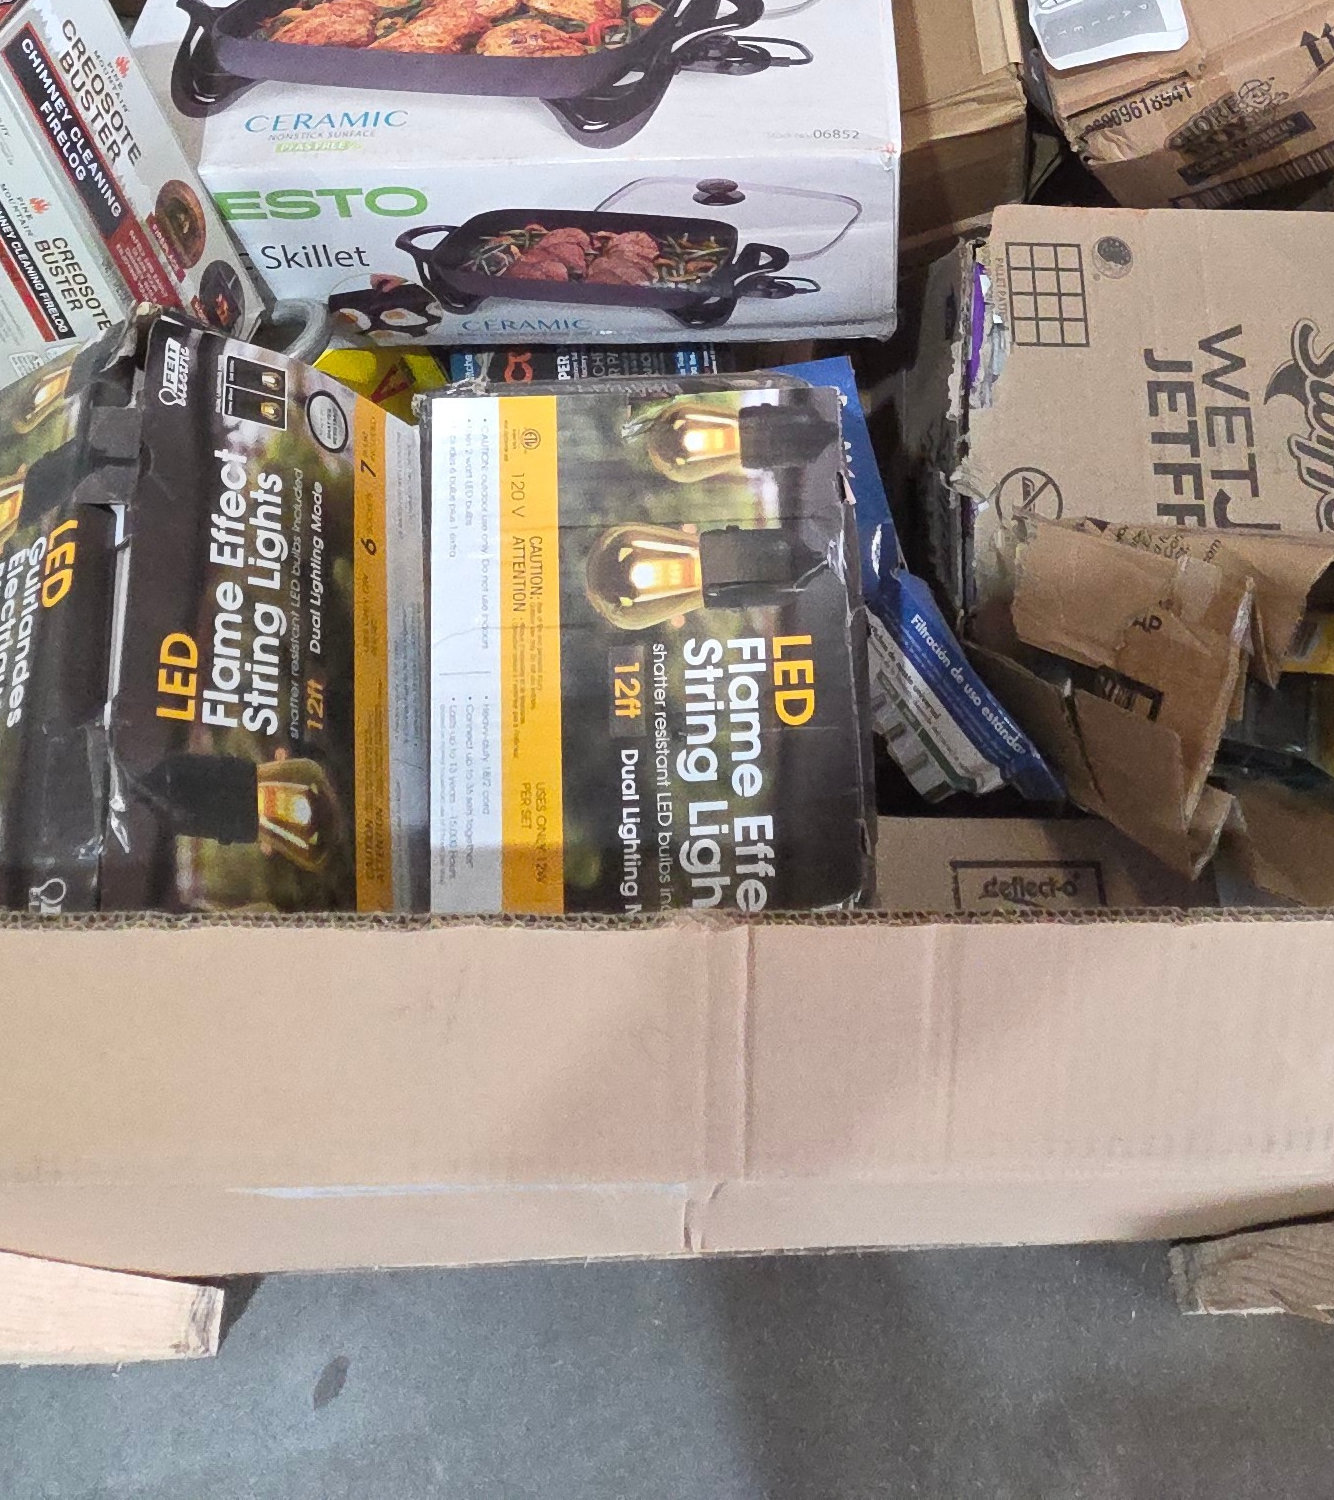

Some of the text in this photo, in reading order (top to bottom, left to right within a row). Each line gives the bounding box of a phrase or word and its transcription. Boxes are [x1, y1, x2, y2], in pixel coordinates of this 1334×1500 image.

[22, 38, 122, 218] CHIMNEY CLEANING
[58, 49, 122, 162] BUSTER
[62, 19, 142, 167] CREOSOTE
[244, 110, 410, 134] CERAMIC
[813, 129, 860, 140] 06852
[39, 100, 87, 182] FIRELOG
[0, 183, 33, 237] MOUNTAIN
[16, 196, 34, 221] PINE
[11, 241, 45, 292] CLEANING
[39, 291, 67, 333] FIRELOG
[34, 240, 84, 312] BUSTER
[52, 237, 112, 331] CREOSOTE
[260, 245, 371, 271] Skillet
[163, 337, 183, 392] FEIT
[462, 318, 594, 333] CERAMIC
[360, 458, 379, 478] 7
[510, 472, 526, 518] 120 V
[41, 518, 79, 609] LED
[201, 446, 251, 730] Flame Effect
[364, 538, 379, 556] 6
[511, 535, 527, 612] ATTENTION
[528, 535, 544, 601] CAUTION:
[7, 535, 47, 728] Guirlandes
[243, 472, 287, 736] String Lights
[288, 468, 303, 740] shatter resistant LED bulbs included
[305, 480, 326, 732] 12ft Dual Lighting Mode
[155, 632, 199, 723] LED
[653, 642, 669, 772] shatter resistant
[677, 637, 723, 784] String
[727, 636, 765, 798] Flame
[773, 634, 816, 726] LED
[950, 666, 982, 707] de uso
[611, 660, 642, 898] 12ft Dual Lighting
